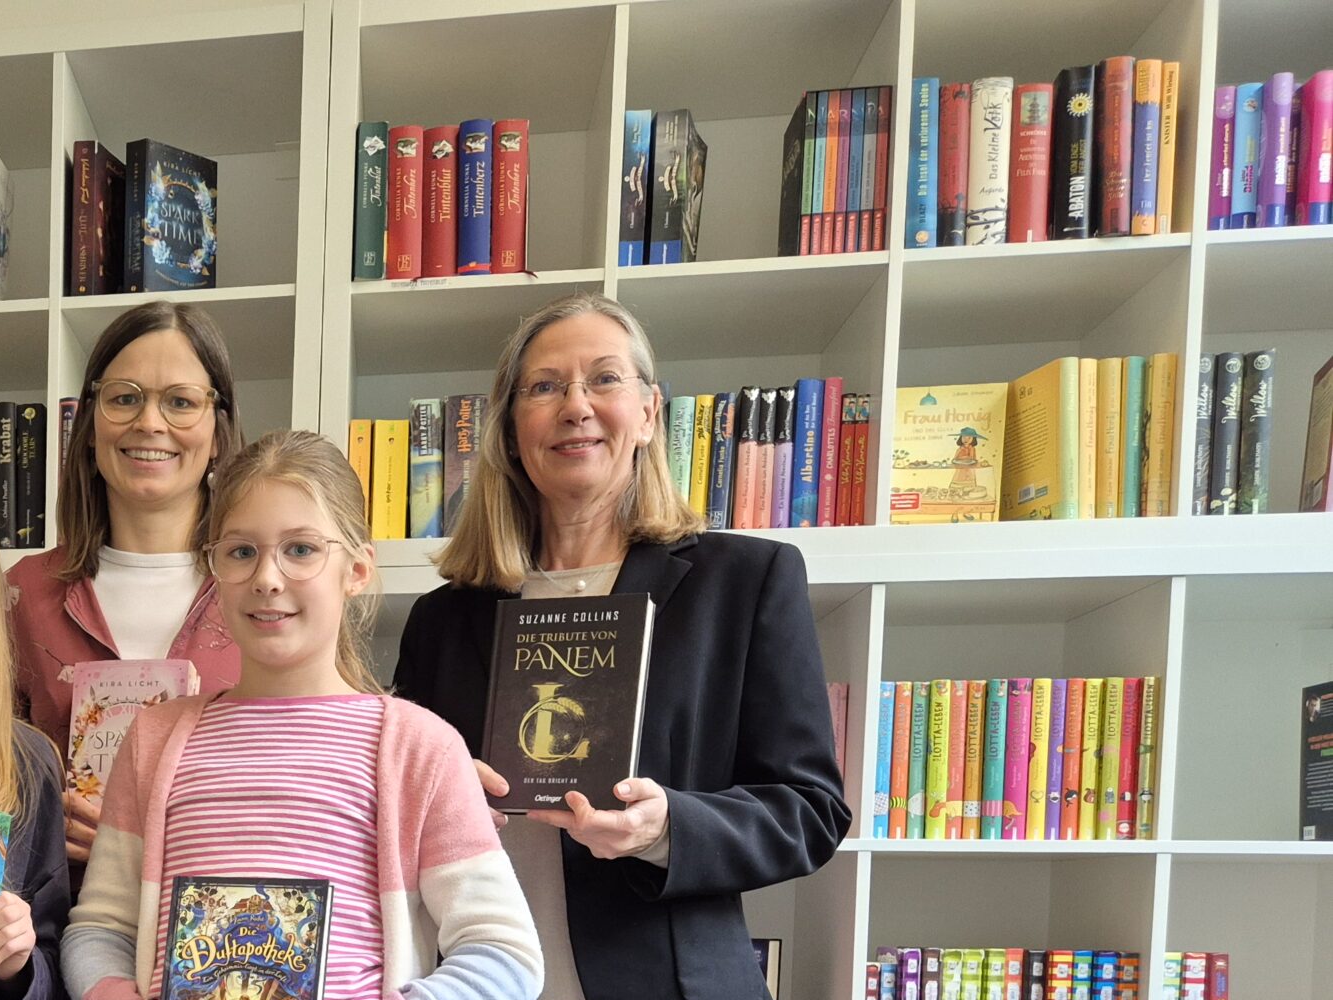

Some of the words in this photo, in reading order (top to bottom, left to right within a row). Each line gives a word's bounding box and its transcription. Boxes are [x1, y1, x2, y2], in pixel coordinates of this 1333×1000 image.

[983, 101, 1004, 132] Volk
[368, 166, 382, 207] Tintenblut
[404, 168, 417, 219] Tintenherz
[471, 161, 485, 217] Tintenherz
[508, 163, 521, 214] Tintenherz
[988, 165, 999, 180] Das
[160, 201, 199, 226] SPARK
[437, 168, 452, 223] Tintenblut
[1069, 176, 1085, 219] ABATON
[160, 219, 202, 246] TIME
[419, 406, 427, 430] POTTER
[455, 399, 472, 427] Potter
[903, 409, 941, 425] Frau
[944, 407, 991, 431] Honig
[1221, 382, 1238, 424] Willow
[1250, 380, 1268, 422] Willow
[0, 418, 12, 464] Krabat
[420, 432, 428, 455] HARRY
[456, 428, 472, 453] Harry
[801, 430, 815, 483] Albertino
[516, 633, 536, 643] DIE
[538, 631, 588, 643] TRIBUTE
[591, 630, 617, 640] VON
[519, 613, 567, 625] SUZANNE
[573, 611, 619, 622] COLLINS
[514, 642, 616, 677] PANEM
[913, 703, 924, 759] LOTTA-LEBEN
[933, 701, 944, 759] LOTTA-LEBEN
[968, 702, 979, 760] LOTTA-LEBEN
[990, 701, 1001, 758] LOTTA-LEBEN
[1035, 684, 1045, 738] LOTTA-LEBEN
[1087, 684, 1098, 737] LOTTA-LEBEN
[1107, 683, 1118, 737] LOTTA-LEBEN
[1144, 683, 1155, 737] LOTTA-LEBEN
[534, 794, 562, 803] Oetinger
[239, 927, 256, 937] Die
[182, 934, 306, 980] Duftapotheke
[215, 964, 243, 979] Geheimnis
